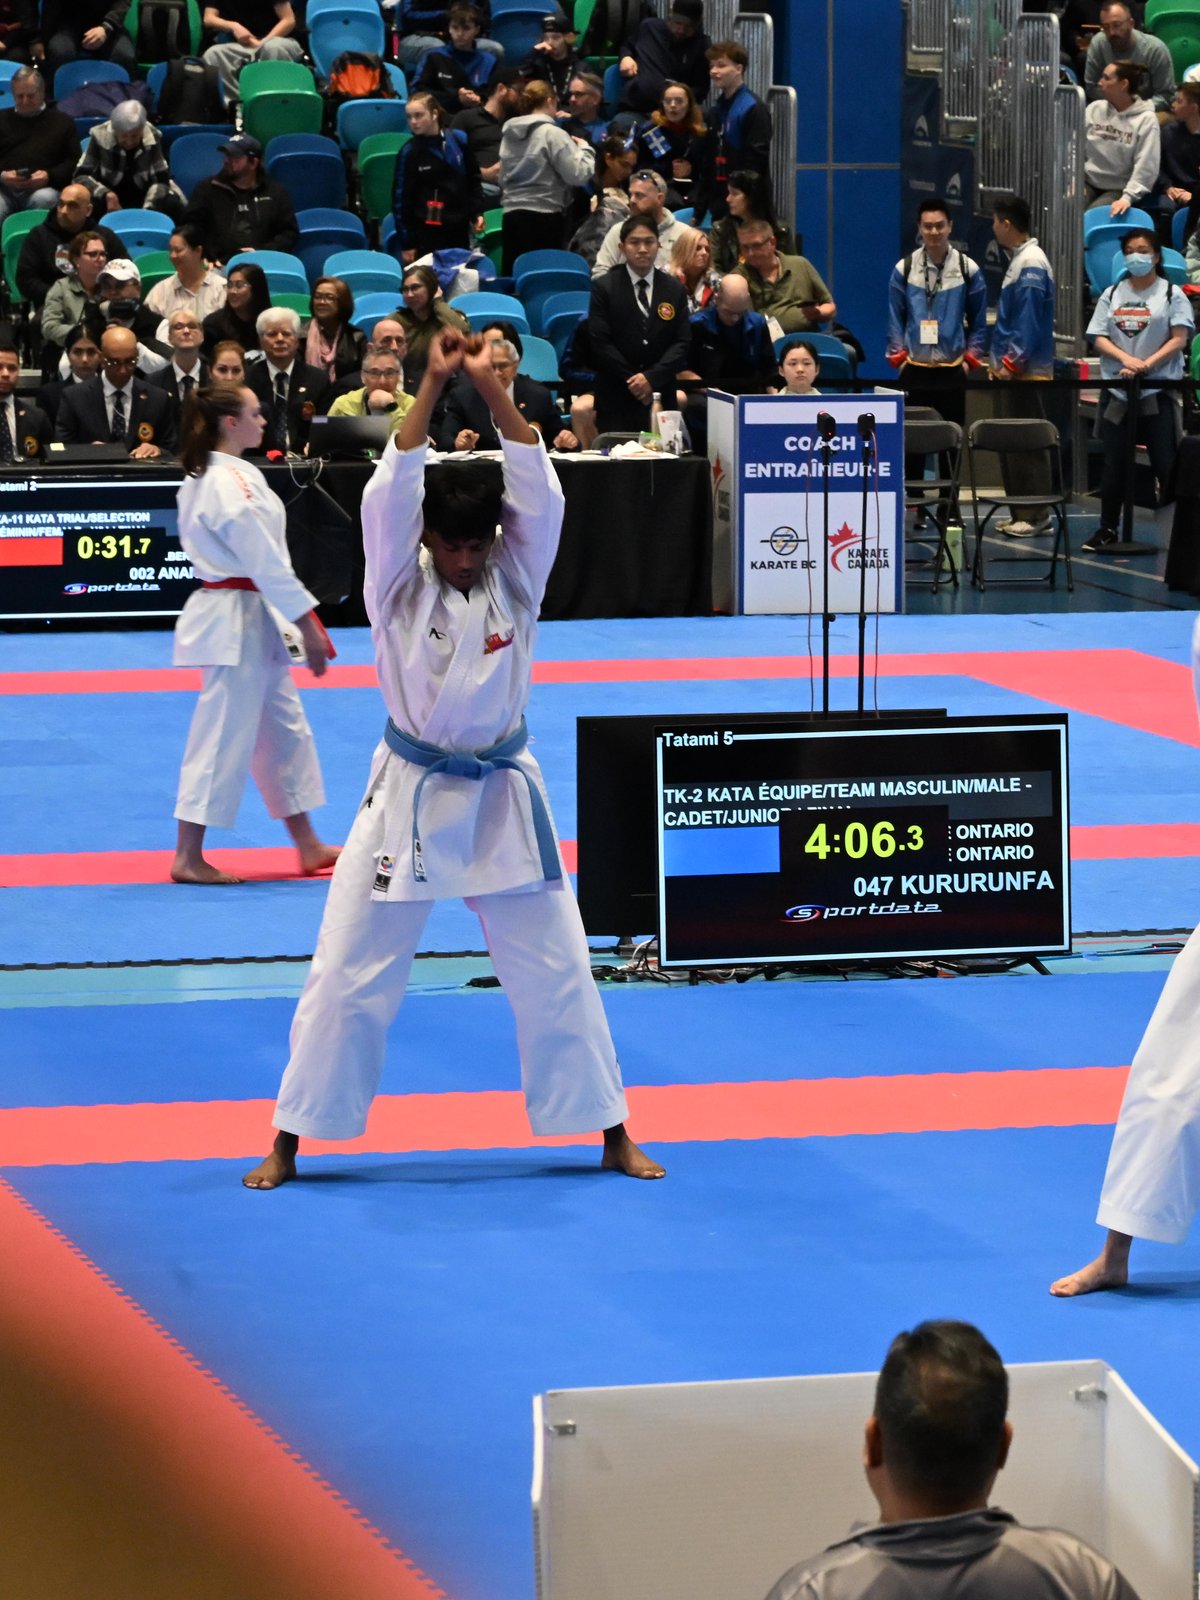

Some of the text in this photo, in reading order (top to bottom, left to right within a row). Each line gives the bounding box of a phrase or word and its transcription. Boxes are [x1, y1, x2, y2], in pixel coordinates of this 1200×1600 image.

[784, 435, 856, 451] COACH
[0, 480, 37, 491] atami 2
[0, 511, 150, 524] A-11 KATA TRIAL/SELECTION
[77, 534, 151, 560] 0:31.7
[129, 567, 155, 580] 002
[750, 560, 817, 570] KARATE BC
[663, 730, 734, 747] Tatami 5
[664, 788, 703, 804] TK-2
[707, 786, 755, 803] KATA
[758, 782, 875, 801] ÉQUIPE/TEAM
[880, 777, 1021, 796] MASCULIN/MALE
[664, 807, 791, 827] CADET/JUNIO
[804, 820, 924, 860] 4:06.3
[955, 822, 1035, 840] ONTARIO
[955, 844, 1035, 862] ONTARIO
[853, 869, 1056, 898] 047 KURURUNFA
